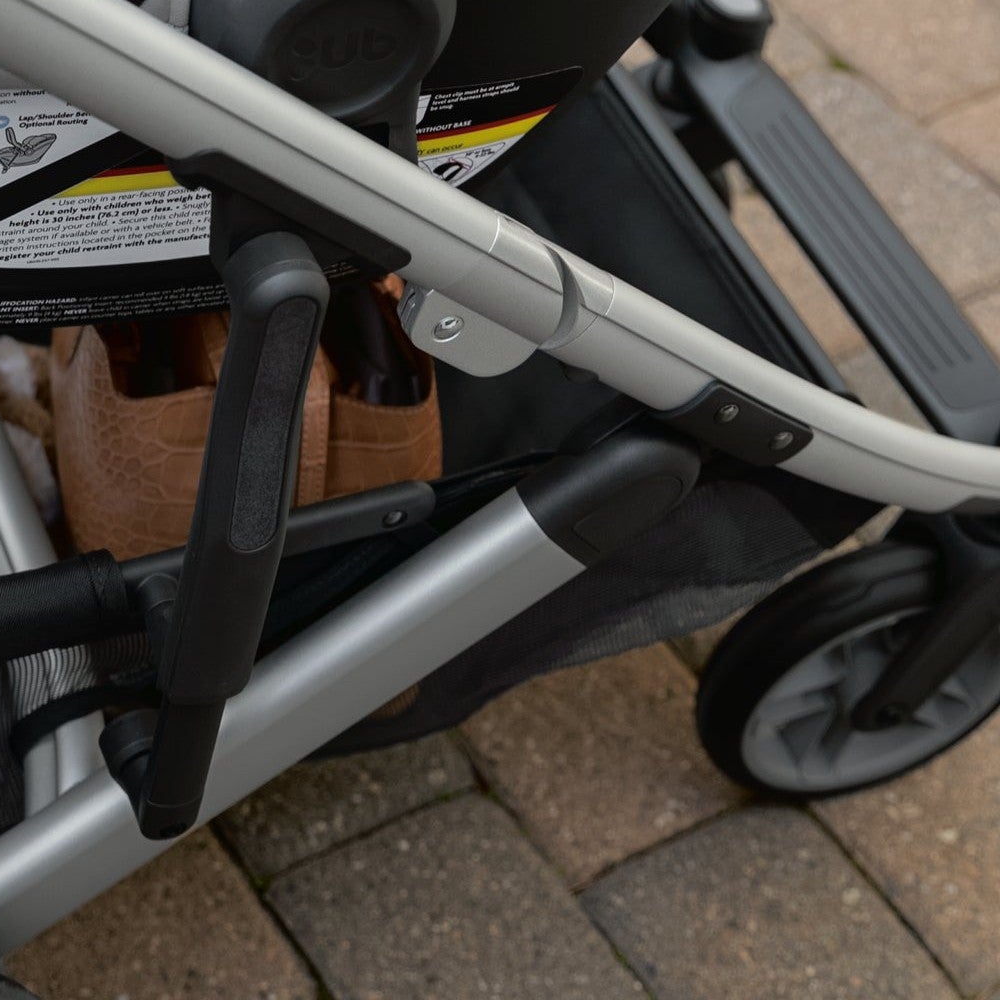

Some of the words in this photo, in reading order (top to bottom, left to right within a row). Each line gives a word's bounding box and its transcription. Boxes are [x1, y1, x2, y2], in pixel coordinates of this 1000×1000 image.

[495, 82, 515, 90] armpit
[500, 86, 520, 94] should
[19, 112, 74, 122] Lap/Shoulder
[19, 121, 55, 129] Optional
[416, 123, 452, 134] WITHOUT
[453, 120, 472, 128] BASE
[78, 197, 98, 205] only
[118, 190, 166, 200] rear-facing
[167, 186, 204, 196] posin
[37, 208, 55, 216] Use
[57, 207, 78, 216] only
[104, 200, 142, 210] children
[167, 195, 193, 203] weigh
[9, 219, 40, 228] height
[66, 214, 95, 222] inches
[97, 211, 120, 220] (76.2
[121, 208, 139, 216] cm)
[183, 201, 210, 209] Snugly
[28, 225, 60, 233] around
[62, 224, 83, 233] your
[118, 217, 148, 225] Secure
[168, 211, 190, 219] child
[17, 236, 49, 244] system
[60, 229, 98, 239] available
[143, 221, 173, 229] vehicle
[26, 240, 79, 250] instructions
[82, 236, 115, 245] located
[145, 229, 175, 239] pocket
[34, 250, 54, 260] your
[58, 247, 80, 255] child
[82, 244, 122, 252] restraint
